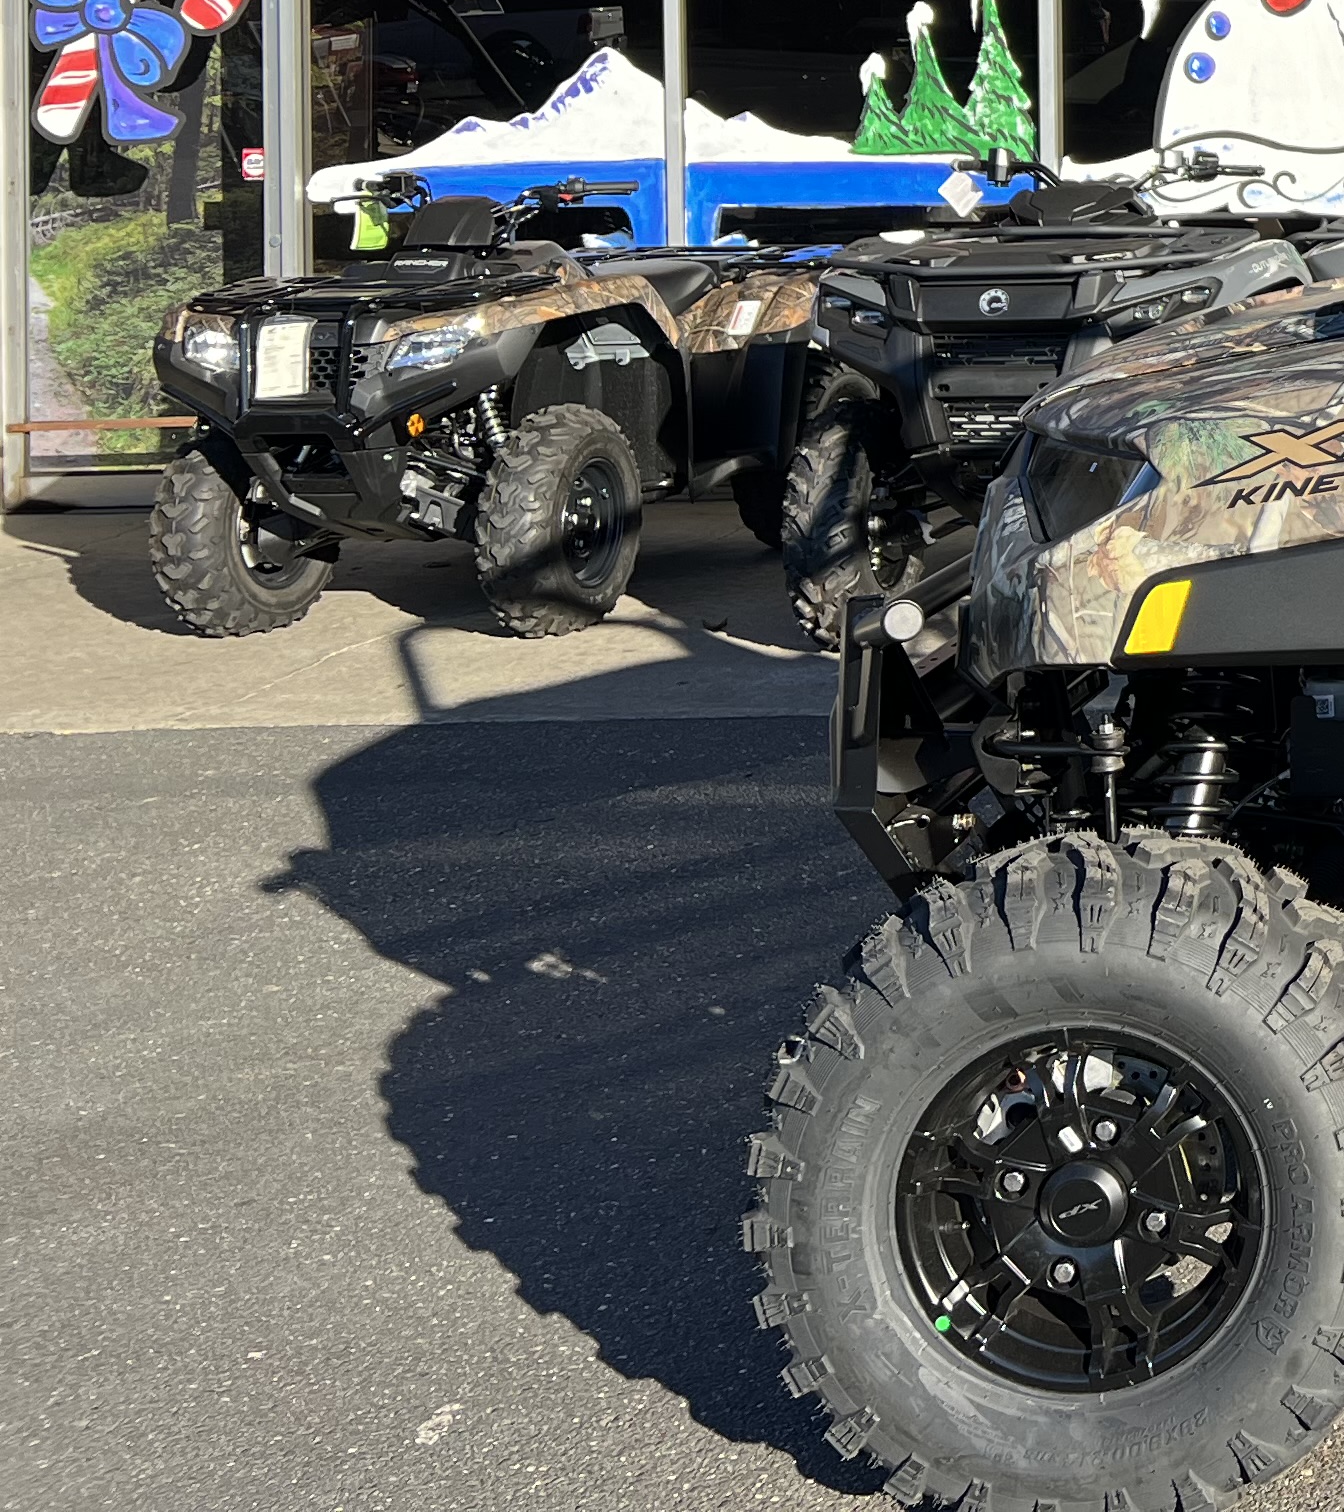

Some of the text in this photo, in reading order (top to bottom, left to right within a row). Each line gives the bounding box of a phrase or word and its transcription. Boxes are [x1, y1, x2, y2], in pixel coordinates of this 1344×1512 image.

[818, 1094, 883, 1323] X-TERRAIN
[1272, 1118, 1315, 1321] PRO ARMOR
